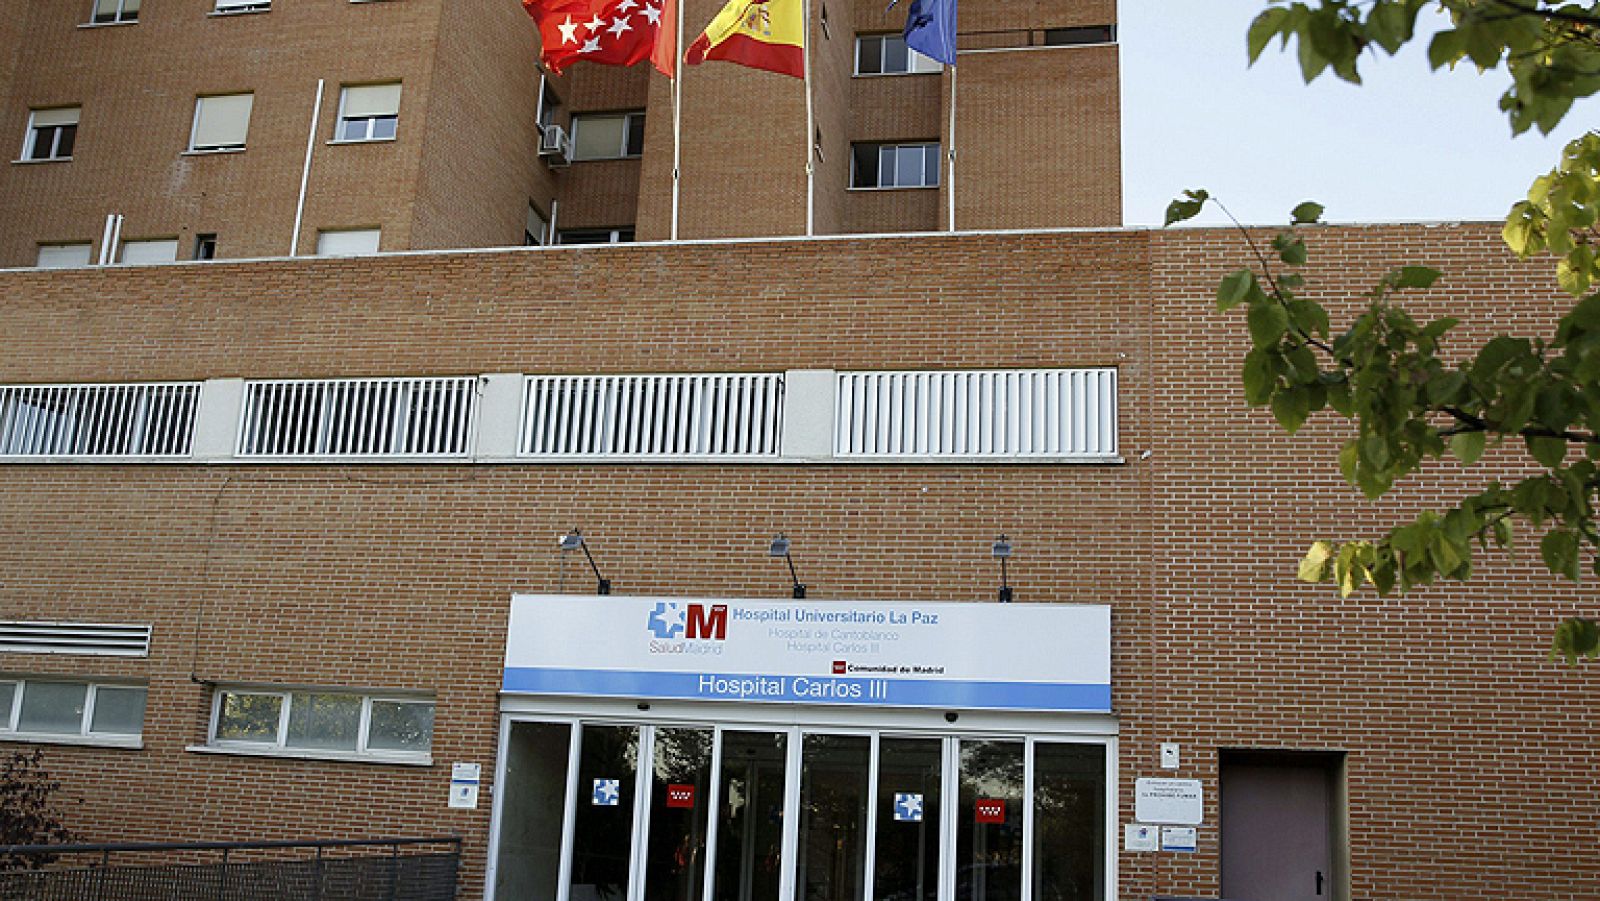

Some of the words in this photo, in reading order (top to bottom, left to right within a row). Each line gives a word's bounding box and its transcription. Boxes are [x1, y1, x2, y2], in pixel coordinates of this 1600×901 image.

[732, 608, 790, 622] Hospital
[795, 608, 886, 623] Universitario
[889, 610, 907, 624] La
[912, 610, 938, 624] Paz
[768, 627, 811, 640] Hospital
[814, 628, 827, 639] de
[831, 628, 899, 641] Cantoblanco
[787, 641, 831, 653] Hospital
[832, 642, 867, 654] Carlos
[870, 643, 880, 653] III
[848, 664, 897, 673] Comunidad
[900, 666, 910, 674] de
[913, 666, 944, 674] Madrid
[699, 674, 784, 697] Hospital
[792, 677, 861, 699] Carlos
[869, 679, 887, 699] III
